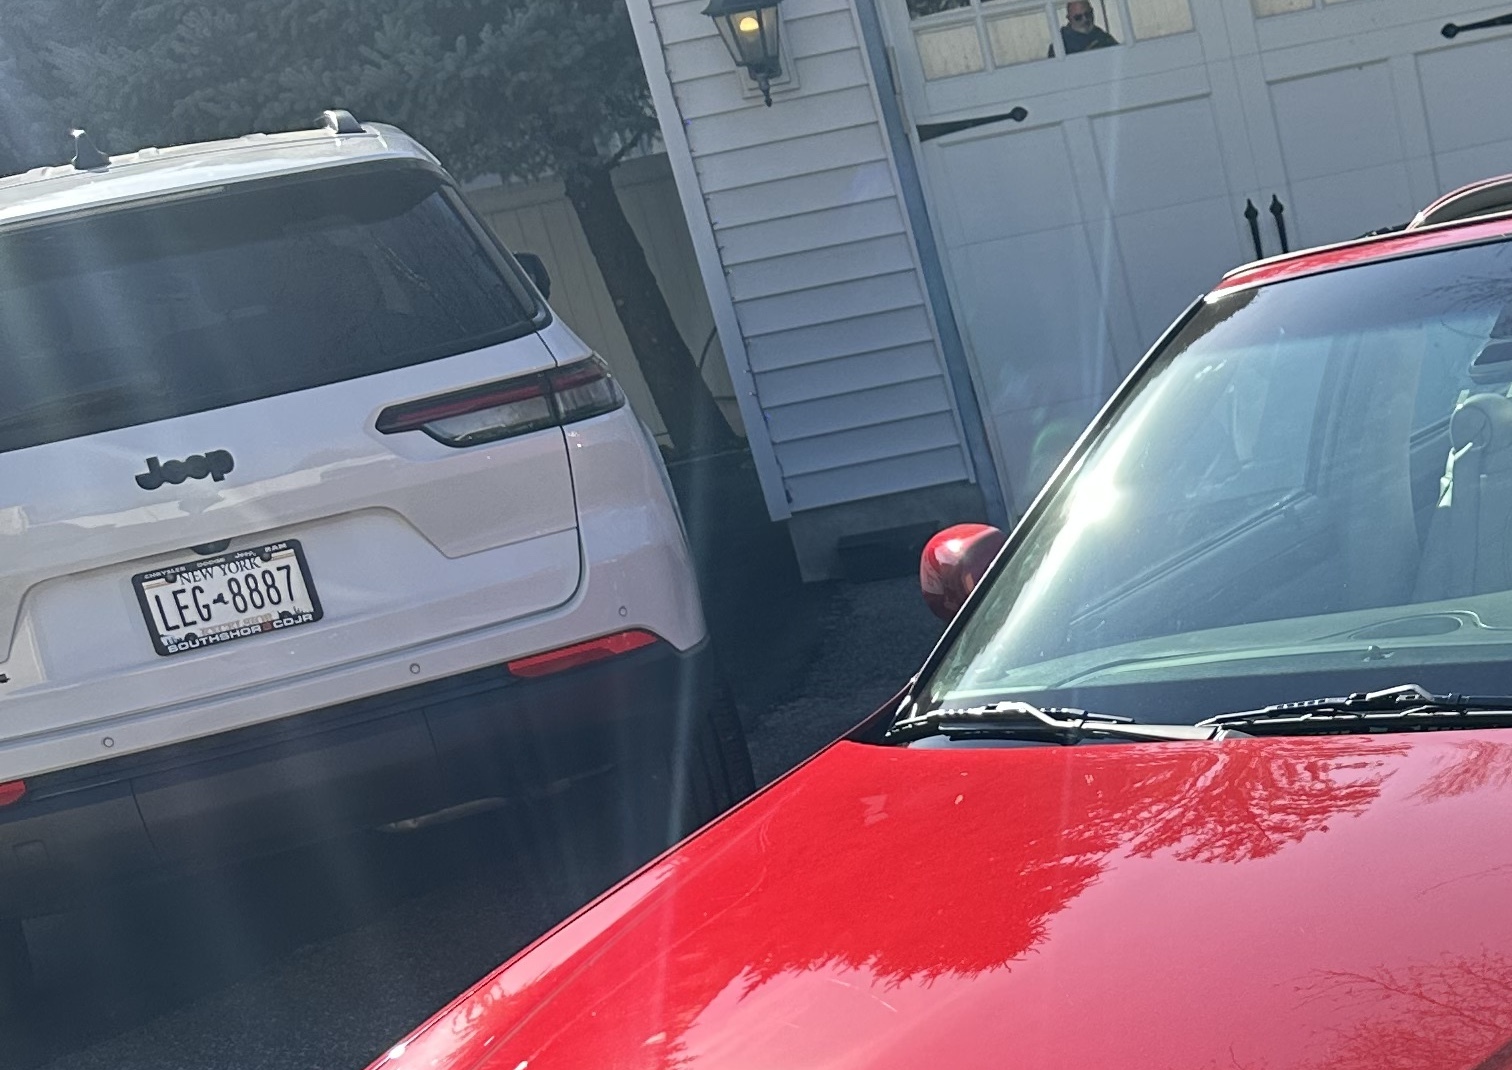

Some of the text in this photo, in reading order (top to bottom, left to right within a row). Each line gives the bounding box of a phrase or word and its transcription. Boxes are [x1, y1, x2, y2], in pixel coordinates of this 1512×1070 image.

[135, 449, 235, 491] Jeep
[264, 543, 288, 553] RAM
[180, 556, 262, 585] NEW YORK
[272, 612, 314, 629] CDJR
